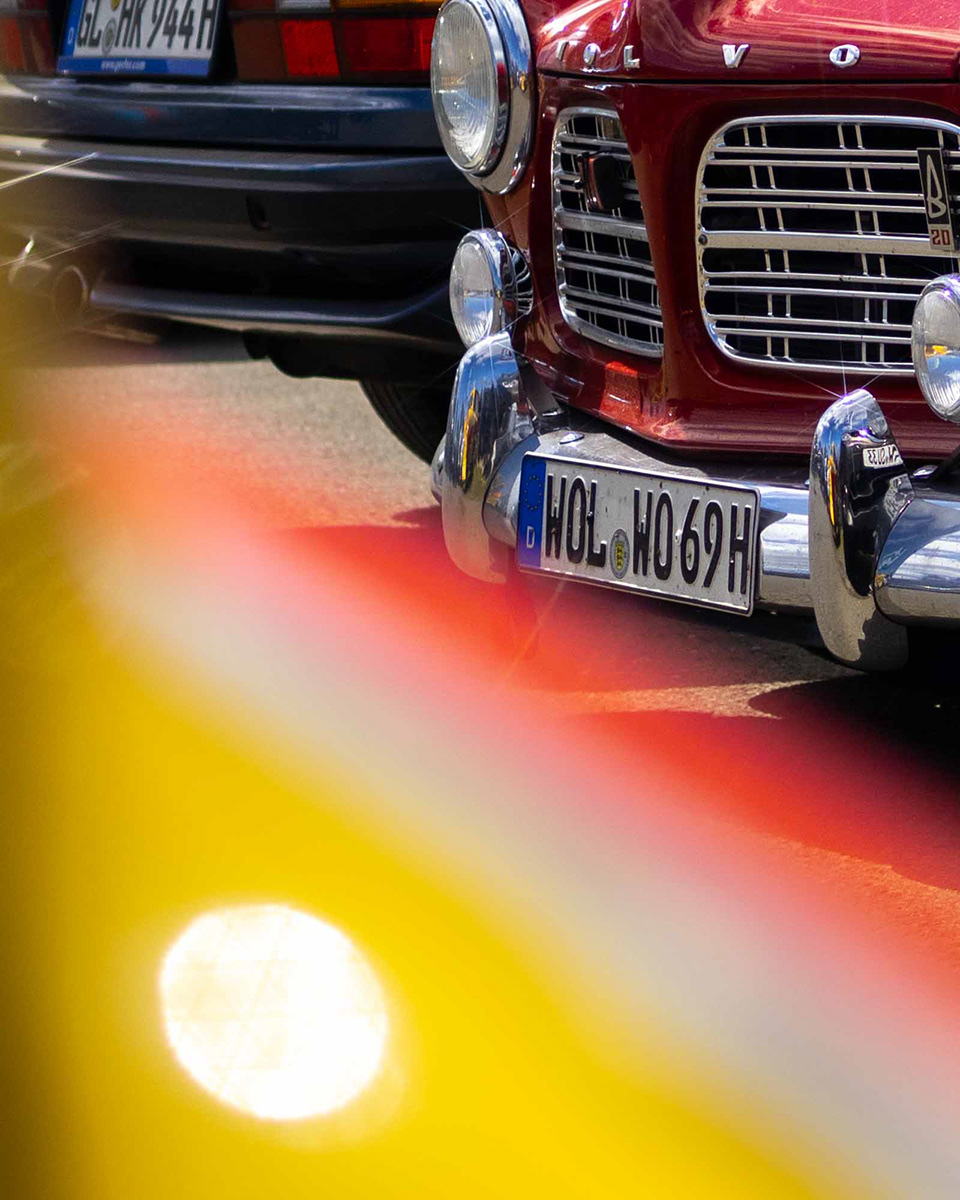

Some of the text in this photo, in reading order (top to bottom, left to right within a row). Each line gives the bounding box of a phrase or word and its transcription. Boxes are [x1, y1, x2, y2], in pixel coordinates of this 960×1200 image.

[931, 229, 950, 246] 20
[525, 525, 536, 549] D
[545, 474, 607, 568] WOL
